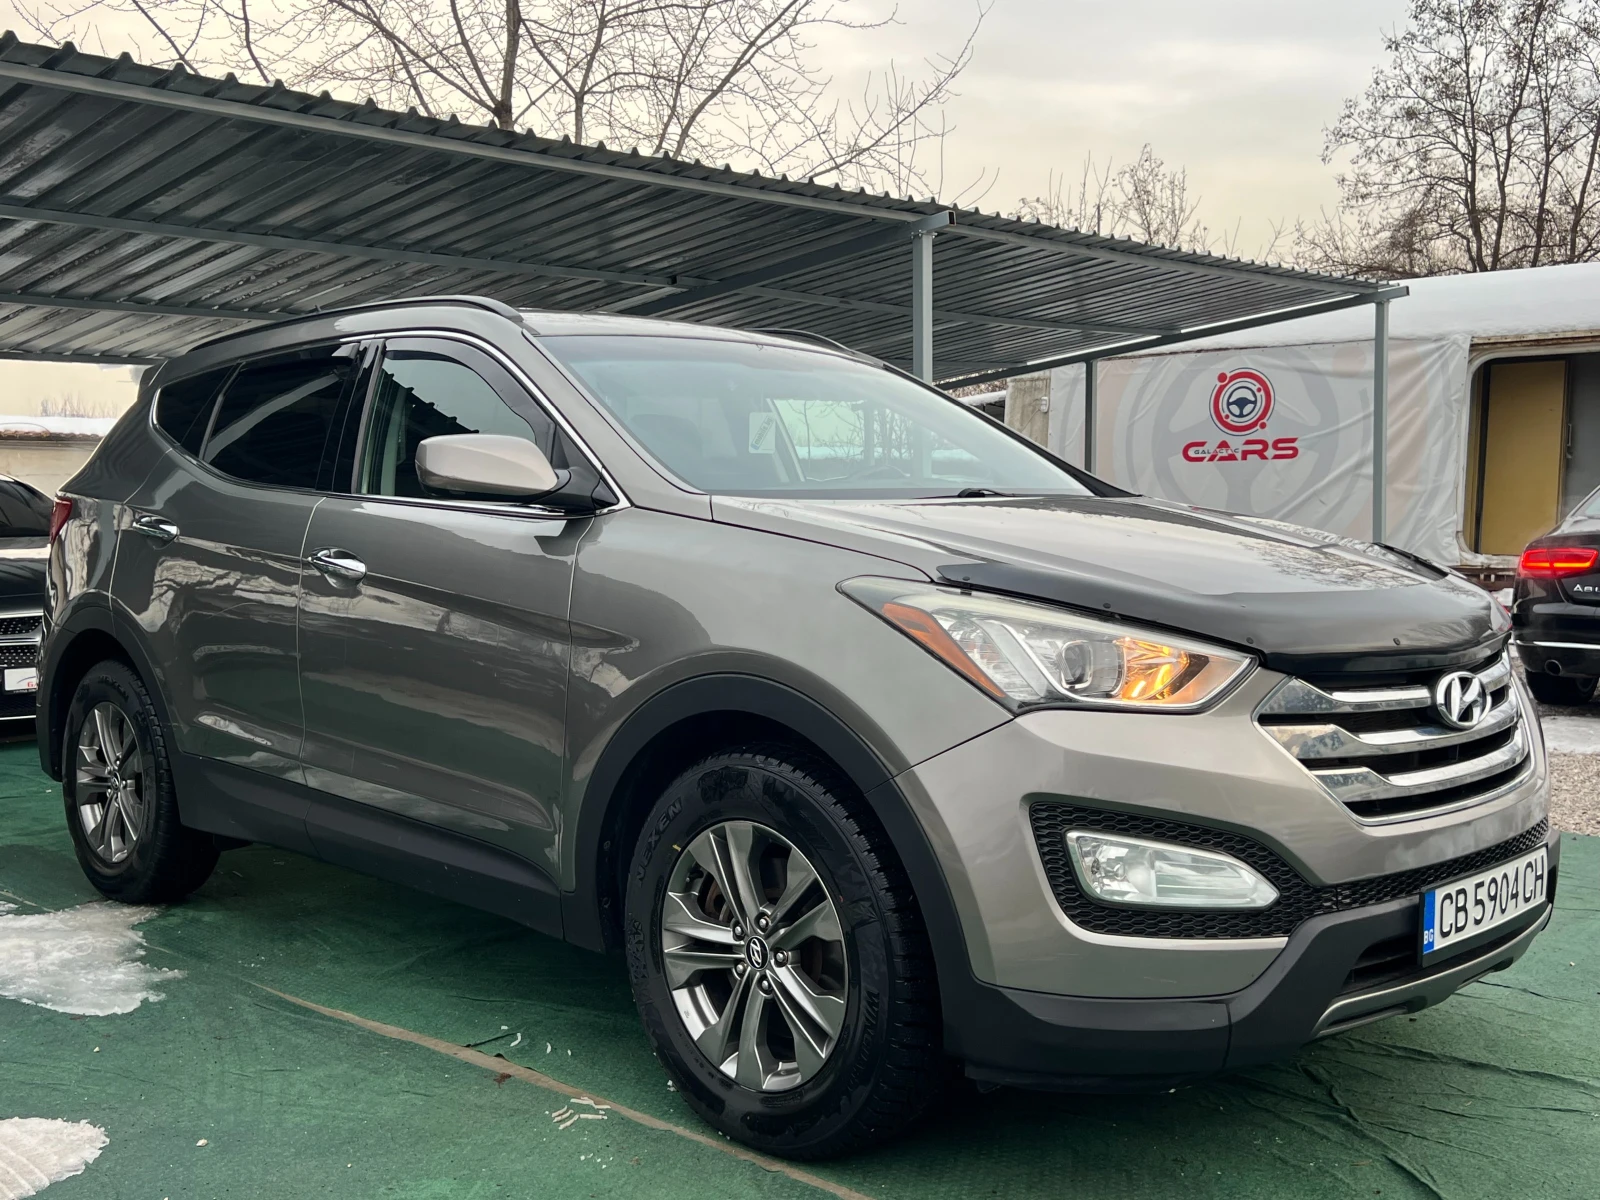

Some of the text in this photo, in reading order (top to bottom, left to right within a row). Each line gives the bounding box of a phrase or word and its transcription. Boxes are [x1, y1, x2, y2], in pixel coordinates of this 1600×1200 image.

[1182, 437, 1299, 462] CARS
[636, 796, 683, 885] NEXEN
[1439, 854, 1545, 939] CB 5904 CH
[1423, 928, 1434, 944] BG
